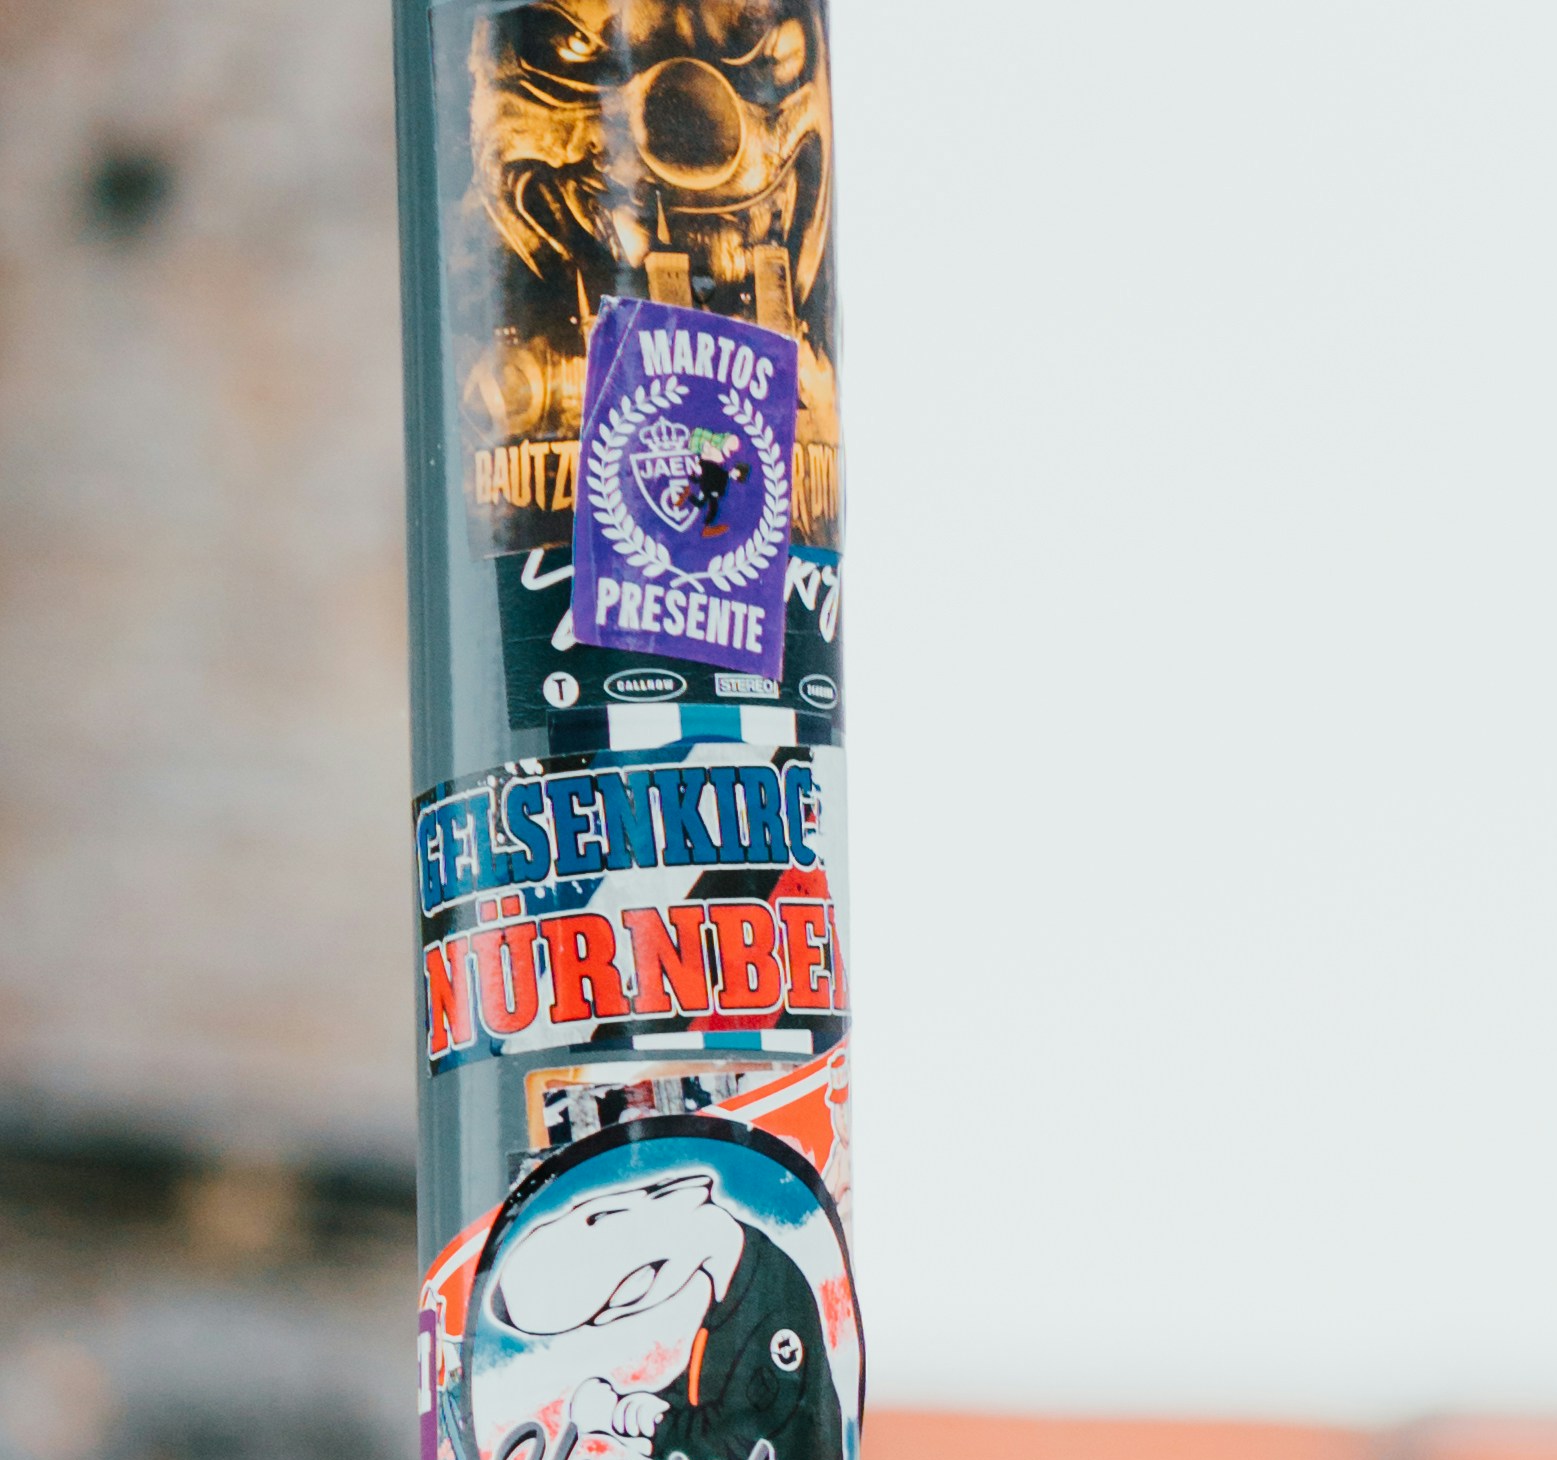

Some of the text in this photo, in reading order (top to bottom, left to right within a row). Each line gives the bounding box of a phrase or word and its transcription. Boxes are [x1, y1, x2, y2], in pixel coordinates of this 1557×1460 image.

[639, 330, 773, 400] MARTOS
[475, 439, 579, 511] BAUTZ
[640, 456, 702, 479] JAEN
[596, 578, 765, 653] PRESENTE
[718, 678, 775, 695] STEREO
[418, 763, 822, 913] GELSENKIRC
